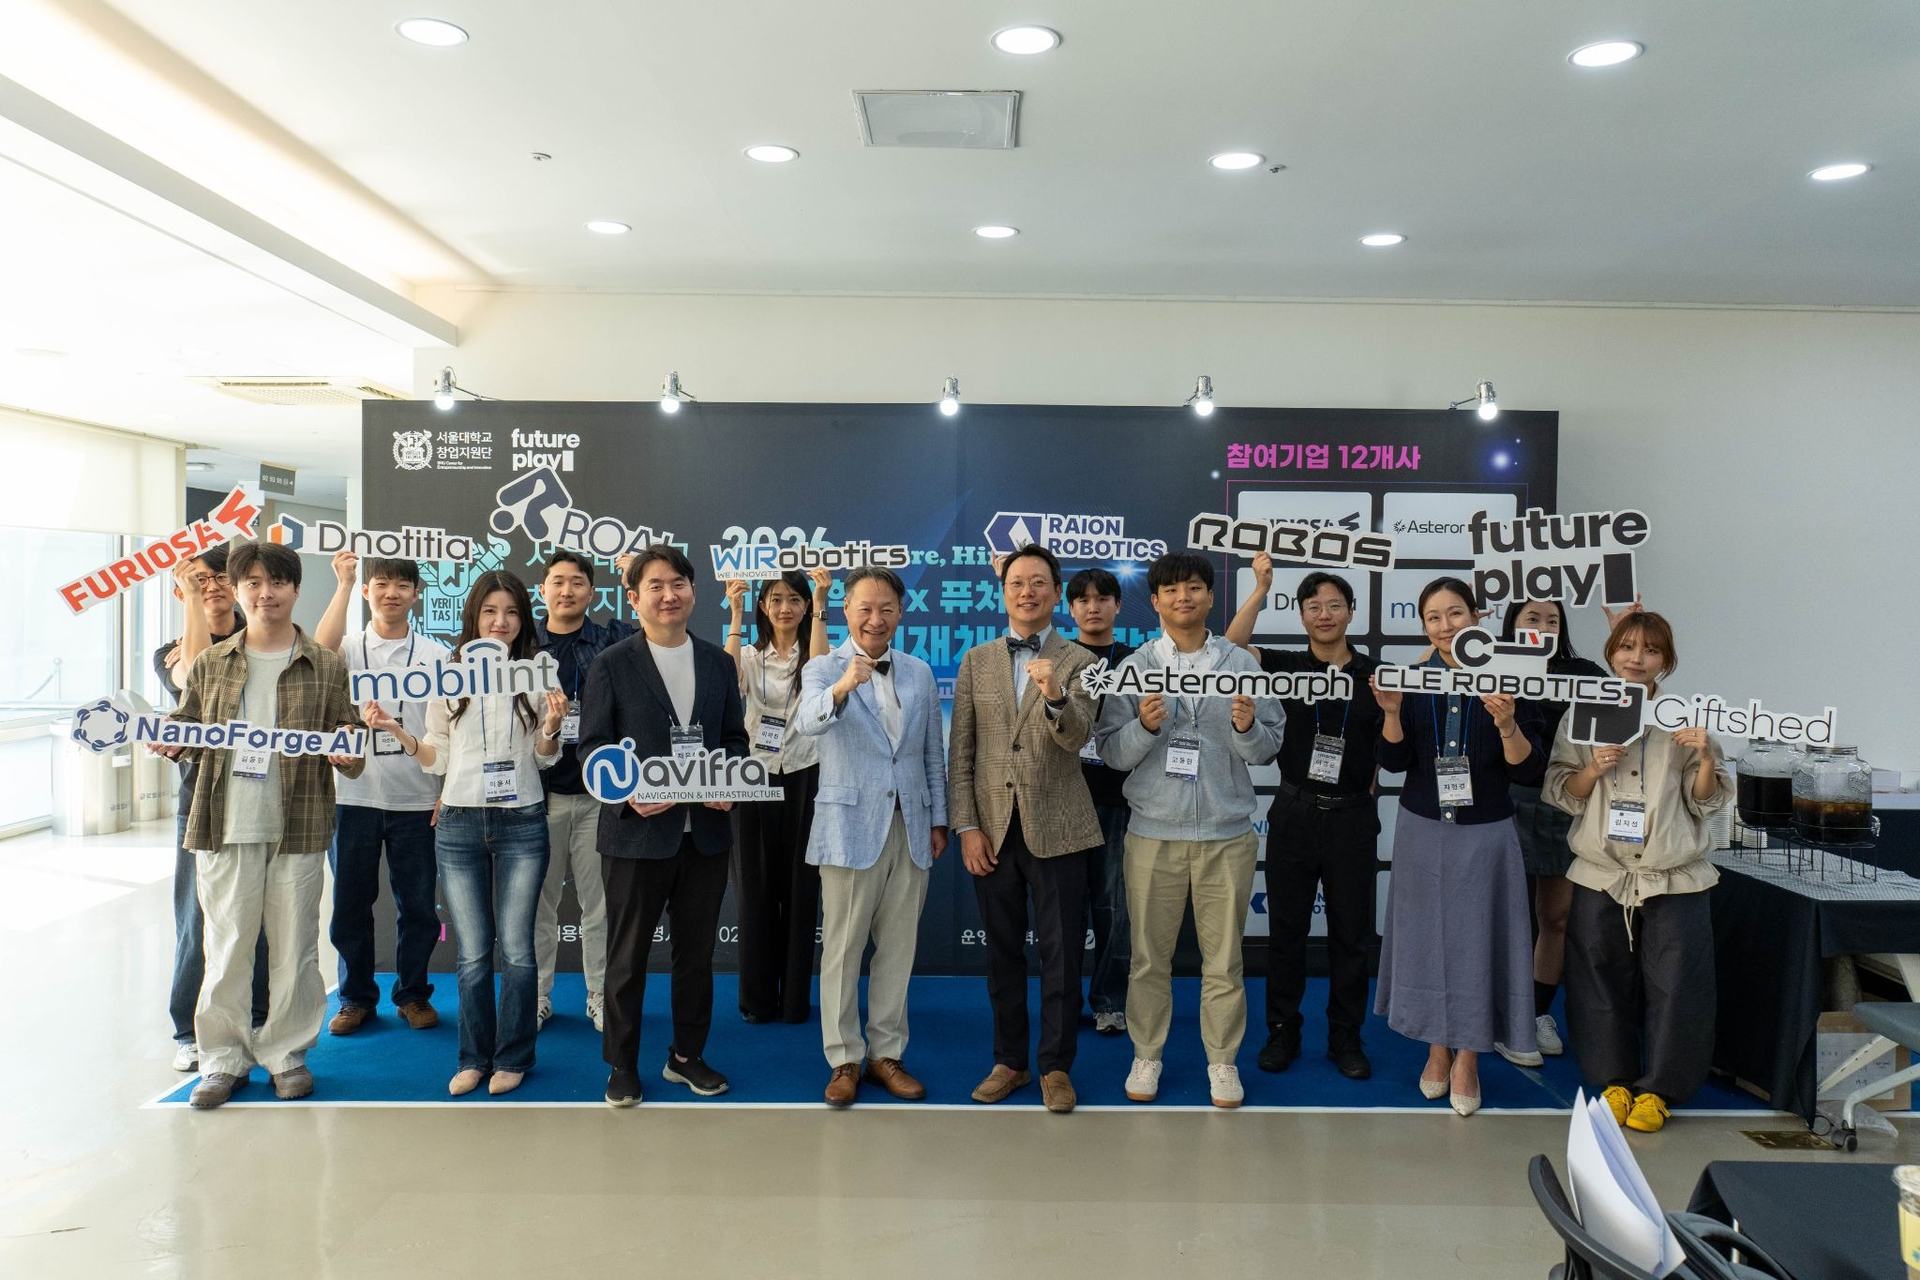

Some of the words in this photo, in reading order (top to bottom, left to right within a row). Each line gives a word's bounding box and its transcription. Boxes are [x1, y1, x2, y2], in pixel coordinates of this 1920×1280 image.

[436, 431, 492, 444] 서울대학교
[511, 428, 580, 448] future
[436, 446, 492, 459] 창업지원단
[512, 450, 562, 472] play
[1227, 443, 1329, 469] 참여기업
[1339, 445, 1421, 470] 12개사
[1049, 518, 1121, 536] RAION
[1468, 510, 1648, 554] future
[319, 523, 470, 561] Dnotitia
[1048, 538, 1166, 560] ROBOTICS
[1193, 517, 1392, 568] ROBOS
[60, 524, 224, 613] FURIOSA
[713, 543, 908, 571] WIRobotics
[1474, 559, 1601, 610] play
[352, 656, 556, 701] mobilint
[1116, 665, 1350, 701] Asteromorph
[1378, 668, 1441, 690] CLE
[1655, 697, 1832, 743] Giftshed
[136, 716, 322, 753] NanoForge
[329, 731, 363, 754] AI
[638, 791, 694, 800] NAVIGATION
[696, 791, 703, 799] &
[705, 790, 781, 799] INFRASTRUCTURE
